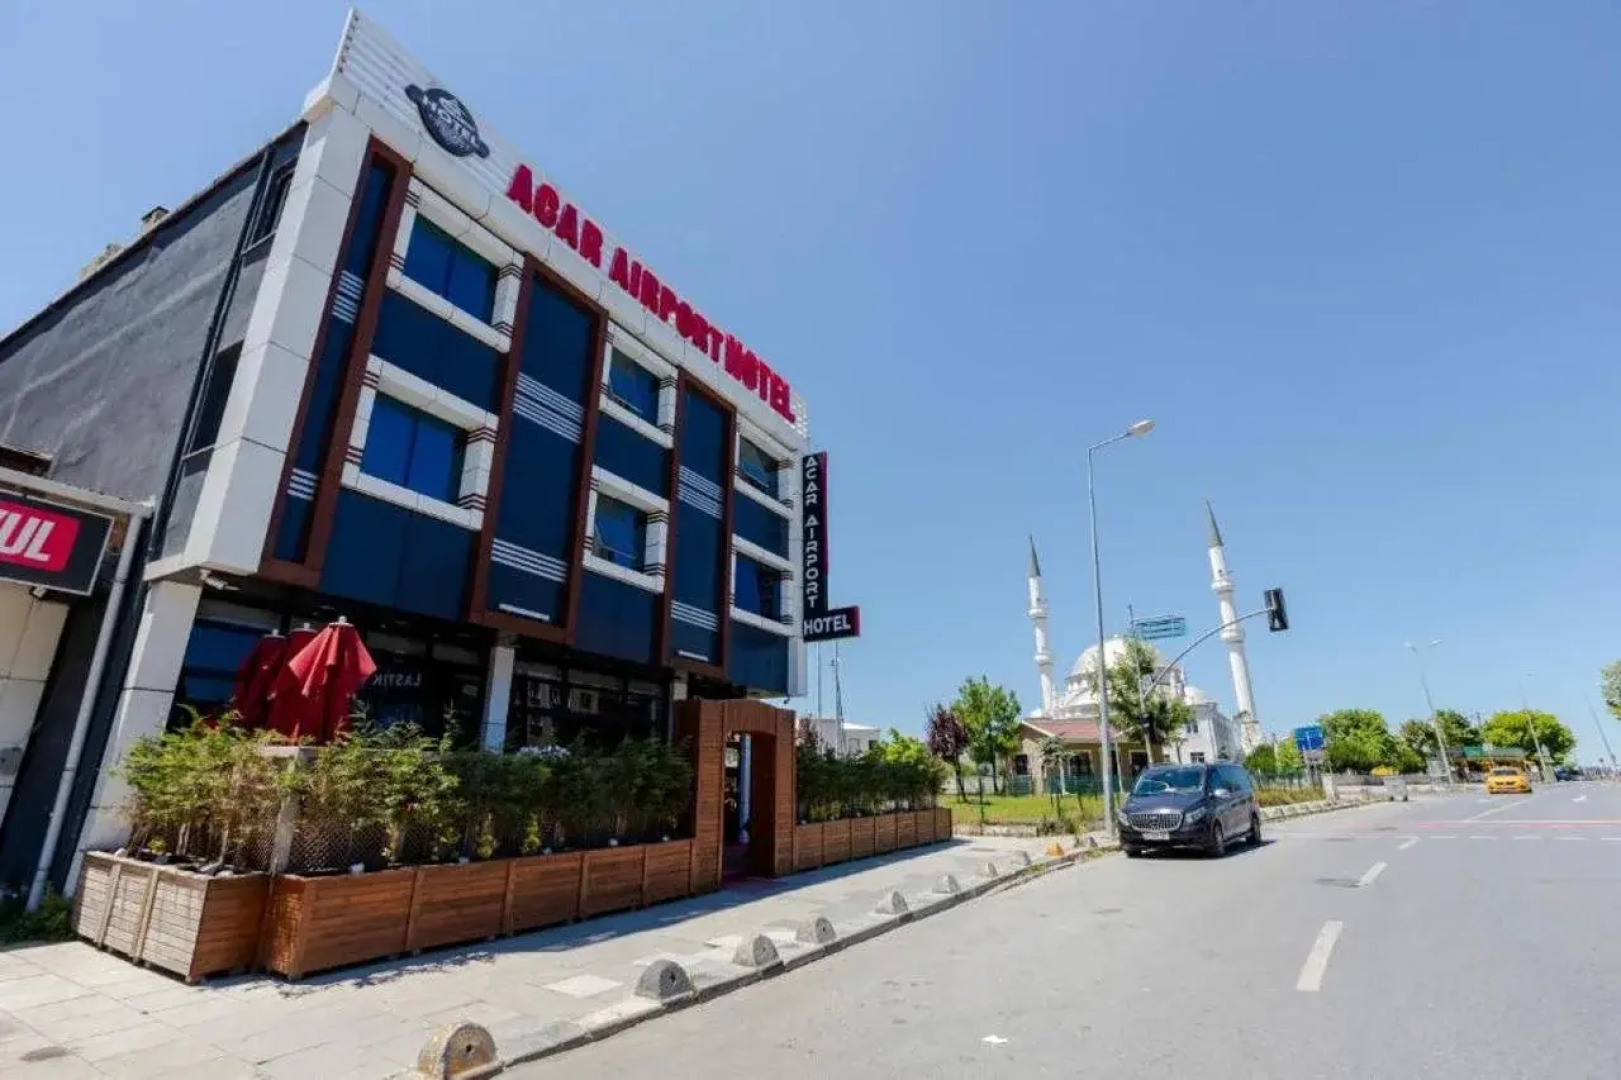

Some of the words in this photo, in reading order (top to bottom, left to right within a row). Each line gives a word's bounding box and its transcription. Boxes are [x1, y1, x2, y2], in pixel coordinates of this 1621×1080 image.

[506, 164, 603, 268] ACAR
[608, 248, 723, 363] AIRPORT
[725, 335, 796, 424] HOTEL
[805, 456, 821, 506] ACAR
[0, 509, 56, 561] UL
[805, 514, 820, 609] AIRPORT
[803, 614, 852, 635] HOTEL
